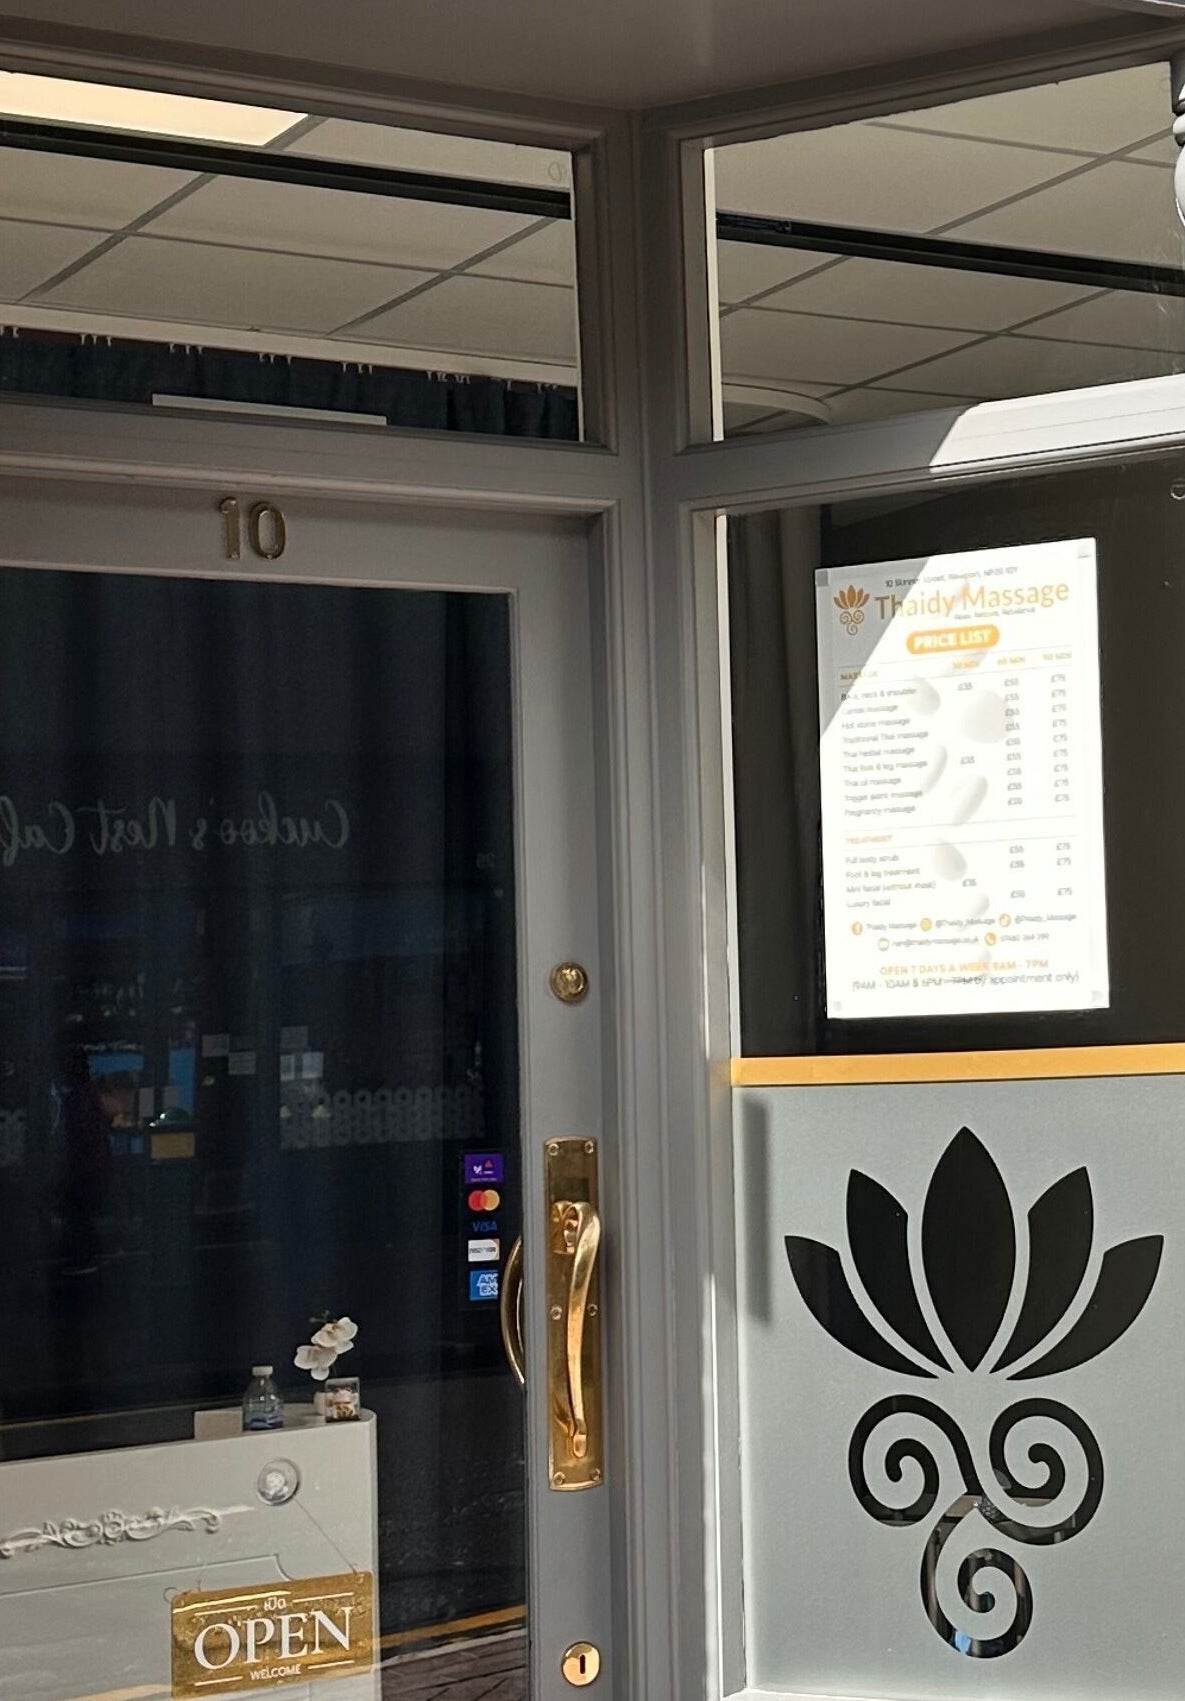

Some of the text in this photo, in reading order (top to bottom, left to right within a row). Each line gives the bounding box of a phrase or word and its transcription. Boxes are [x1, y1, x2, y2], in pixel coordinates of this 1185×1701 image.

[218, 496, 286, 560] 10
[874, 589, 955, 619] Thaidy
[963, 580, 1070, 610] Massage
[914, 629, 992, 650] PRICE LIST
[878, 718, 910, 727] massage
[880, 732, 895, 740] Thai
[896, 731, 928, 740] massage
[883, 746, 915, 756] massage
[843, 764, 858, 772] Thai
[895, 760, 927, 770] massage
[869, 777, 901, 787] massage
[890, 790, 923, 800] massage
[883, 805, 915, 815] massage
[880, 965, 907, 975] OPEN
[919, 964, 945, 973] DAYS
[1025, 959, 1048, 969] 7PM
[921, 977, 941, 987] 6PM
[990, 972, 1052, 985] appointment
[1055, 971, 1079, 982] only)
[472, 1220, 498, 1233] VISA
[194, 1606, 353, 1670] OPEN
[250, 1664, 302, 1681] WELCOME
